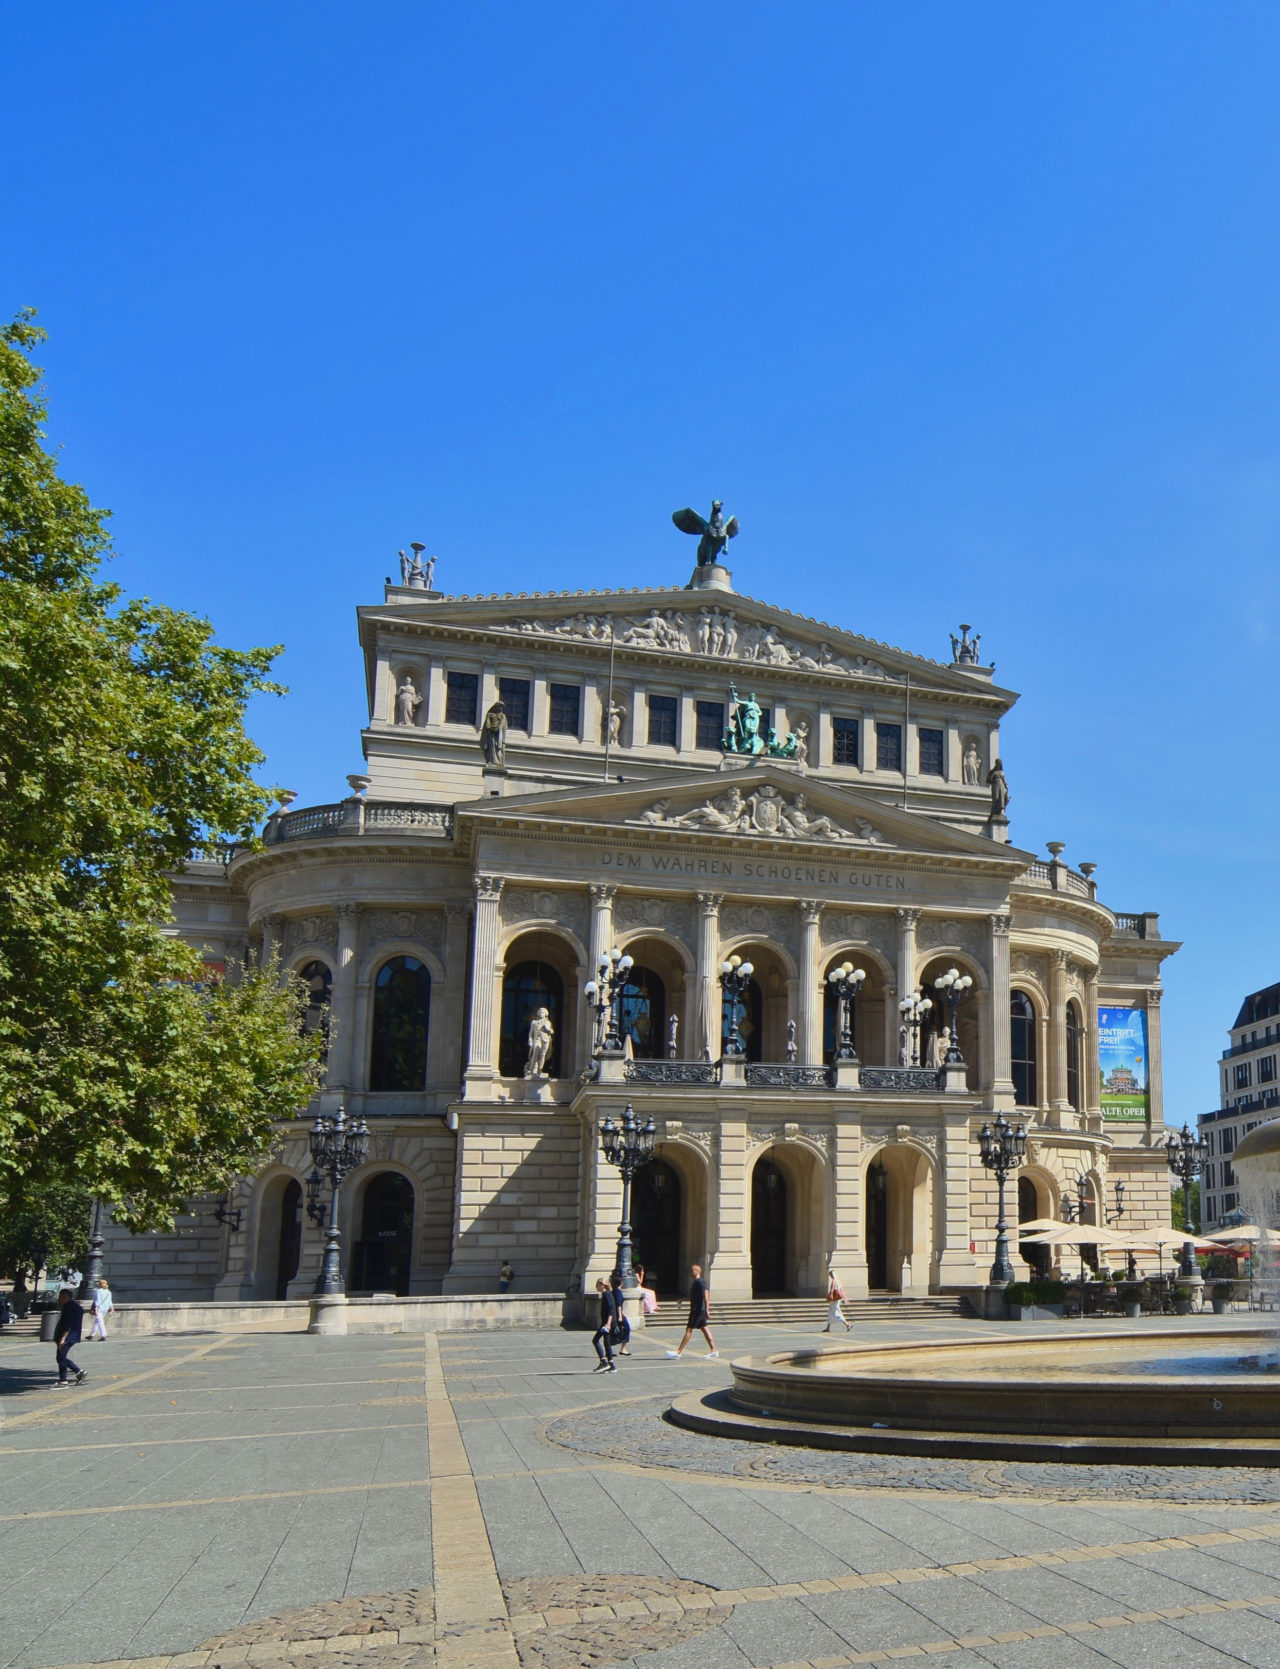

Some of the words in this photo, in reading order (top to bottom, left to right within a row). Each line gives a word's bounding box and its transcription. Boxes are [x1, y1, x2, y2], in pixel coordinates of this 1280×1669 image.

[601, 851, 642, 868] DEM
[651, 855, 732, 875] WAHREN
[743, 863, 839, 884] SCHOENEN
[1098, 1027, 1135, 1037] EINTRITT
[1101, 1106, 1122, 1116] ALTE
[1123, 1107, 1145, 1117] OPER
